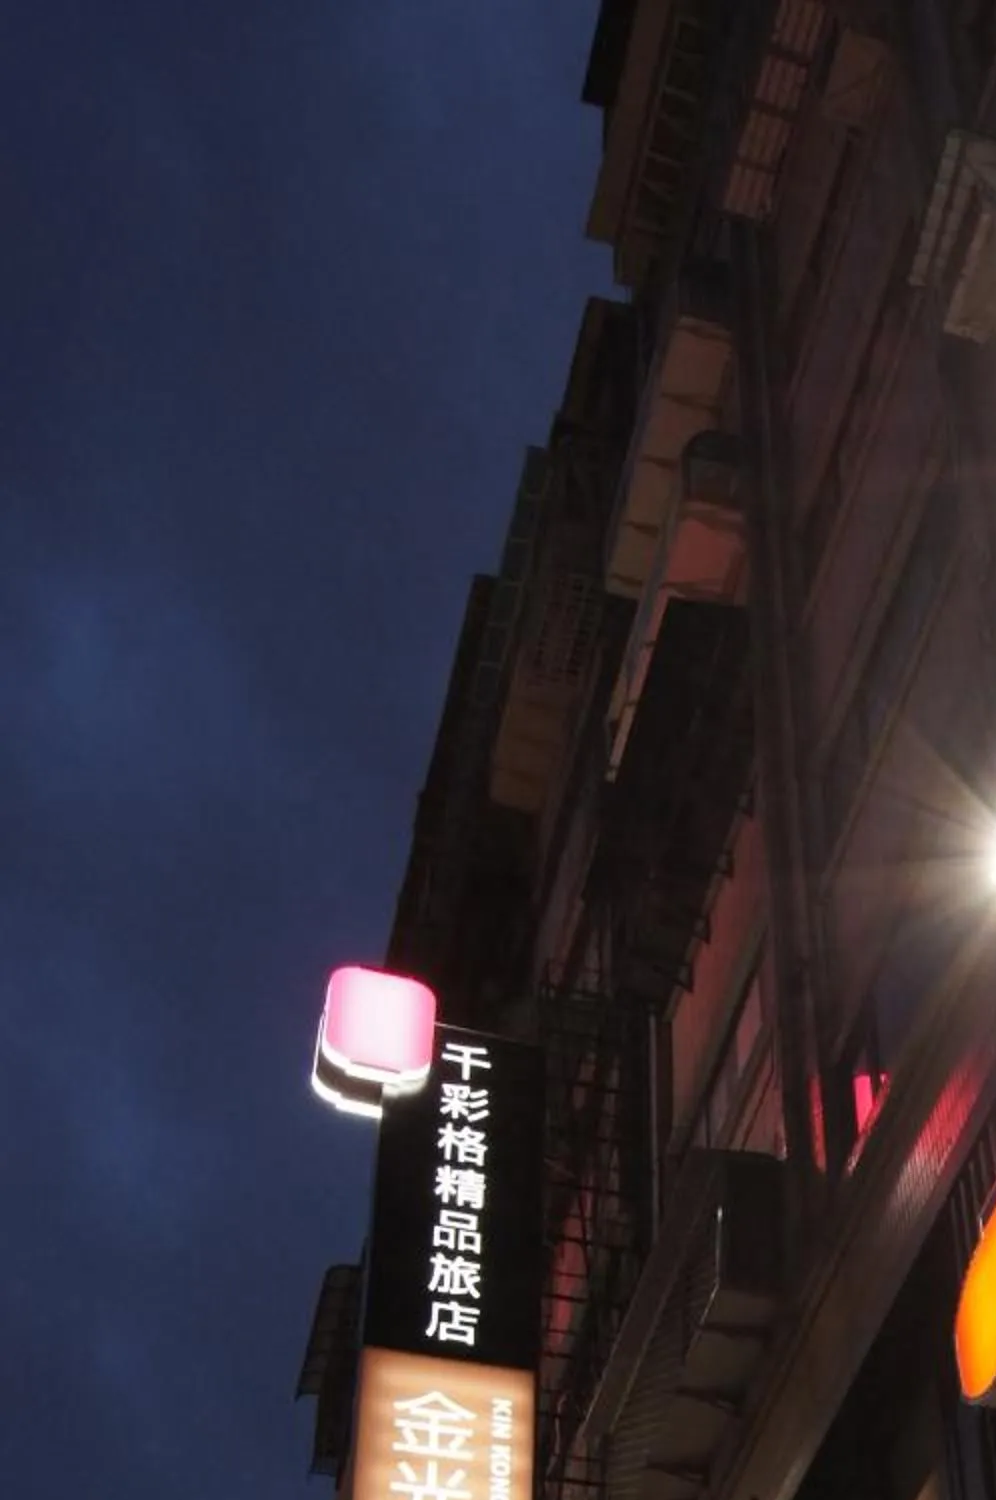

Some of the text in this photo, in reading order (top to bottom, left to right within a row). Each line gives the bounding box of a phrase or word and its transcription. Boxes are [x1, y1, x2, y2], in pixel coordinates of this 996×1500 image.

[425, 1043, 491, 1346] 千彩格精品旅店
[491, 1397, 513, 1440] KIN
